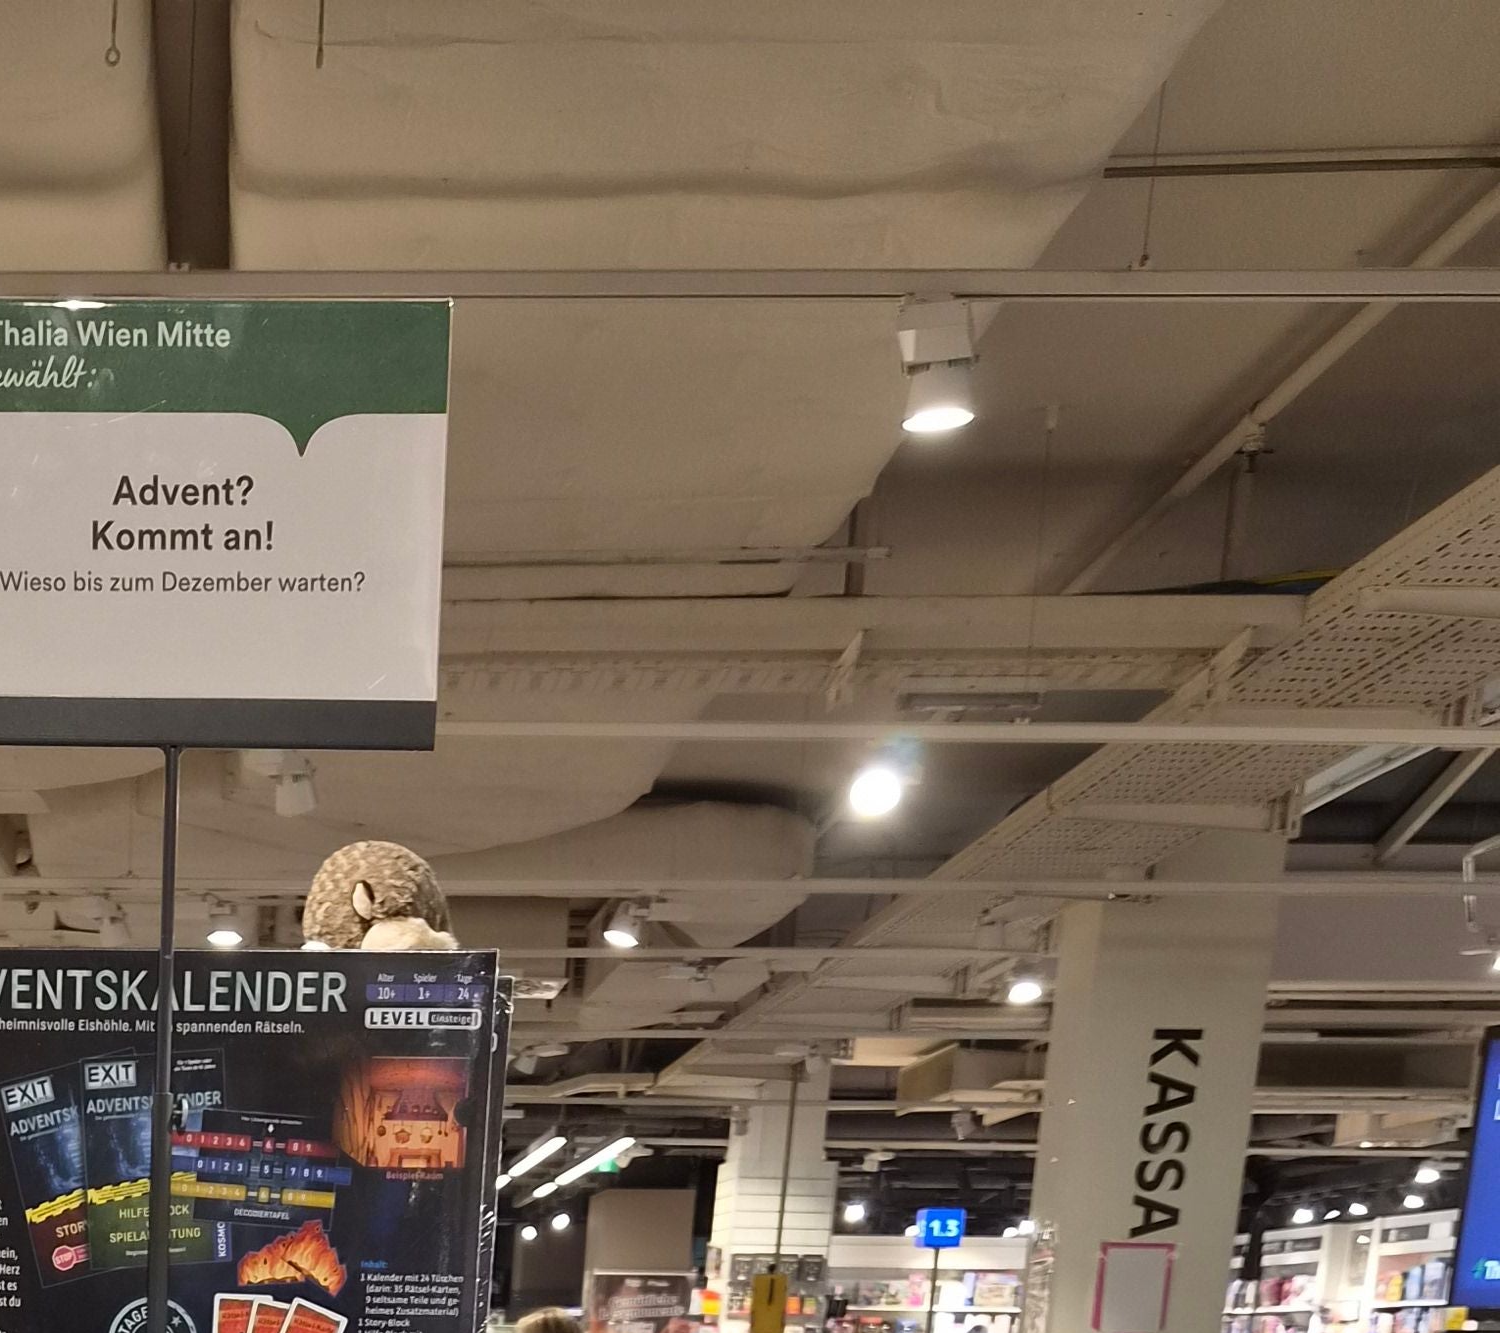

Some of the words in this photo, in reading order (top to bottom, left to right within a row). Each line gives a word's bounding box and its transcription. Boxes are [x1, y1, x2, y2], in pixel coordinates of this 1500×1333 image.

[76, 319, 148, 348] Wien
[157, 320, 231, 348] Mitte
[113, 473, 254, 507] Advent?
[91, 519, 214, 551] Kommt
[223, 519, 275, 551] an!
[0, 570, 67, 592] Wieso
[73, 570, 104, 592] bis
[109, 575, 154, 592] zum
[161, 571, 272, 592] Dezember
[278, 571, 366, 593] warten?
[377, 972, 395, 983] Alter
[412, 973, 437, 985] Spieler
[377, 986, 396, 1000] 10+
[417, 986, 431, 1000] 1+
[78, 1017, 132, 1035] Eishöhle.
[134, 1020, 156, 1033] Mit
[175, 1021, 253, 1036] spannenden
[254, 1018, 306, 1034] Rätseln.
[368, 1010, 425, 1026] LEVEL
[1128, 1027, 1204, 1239] KASSA
